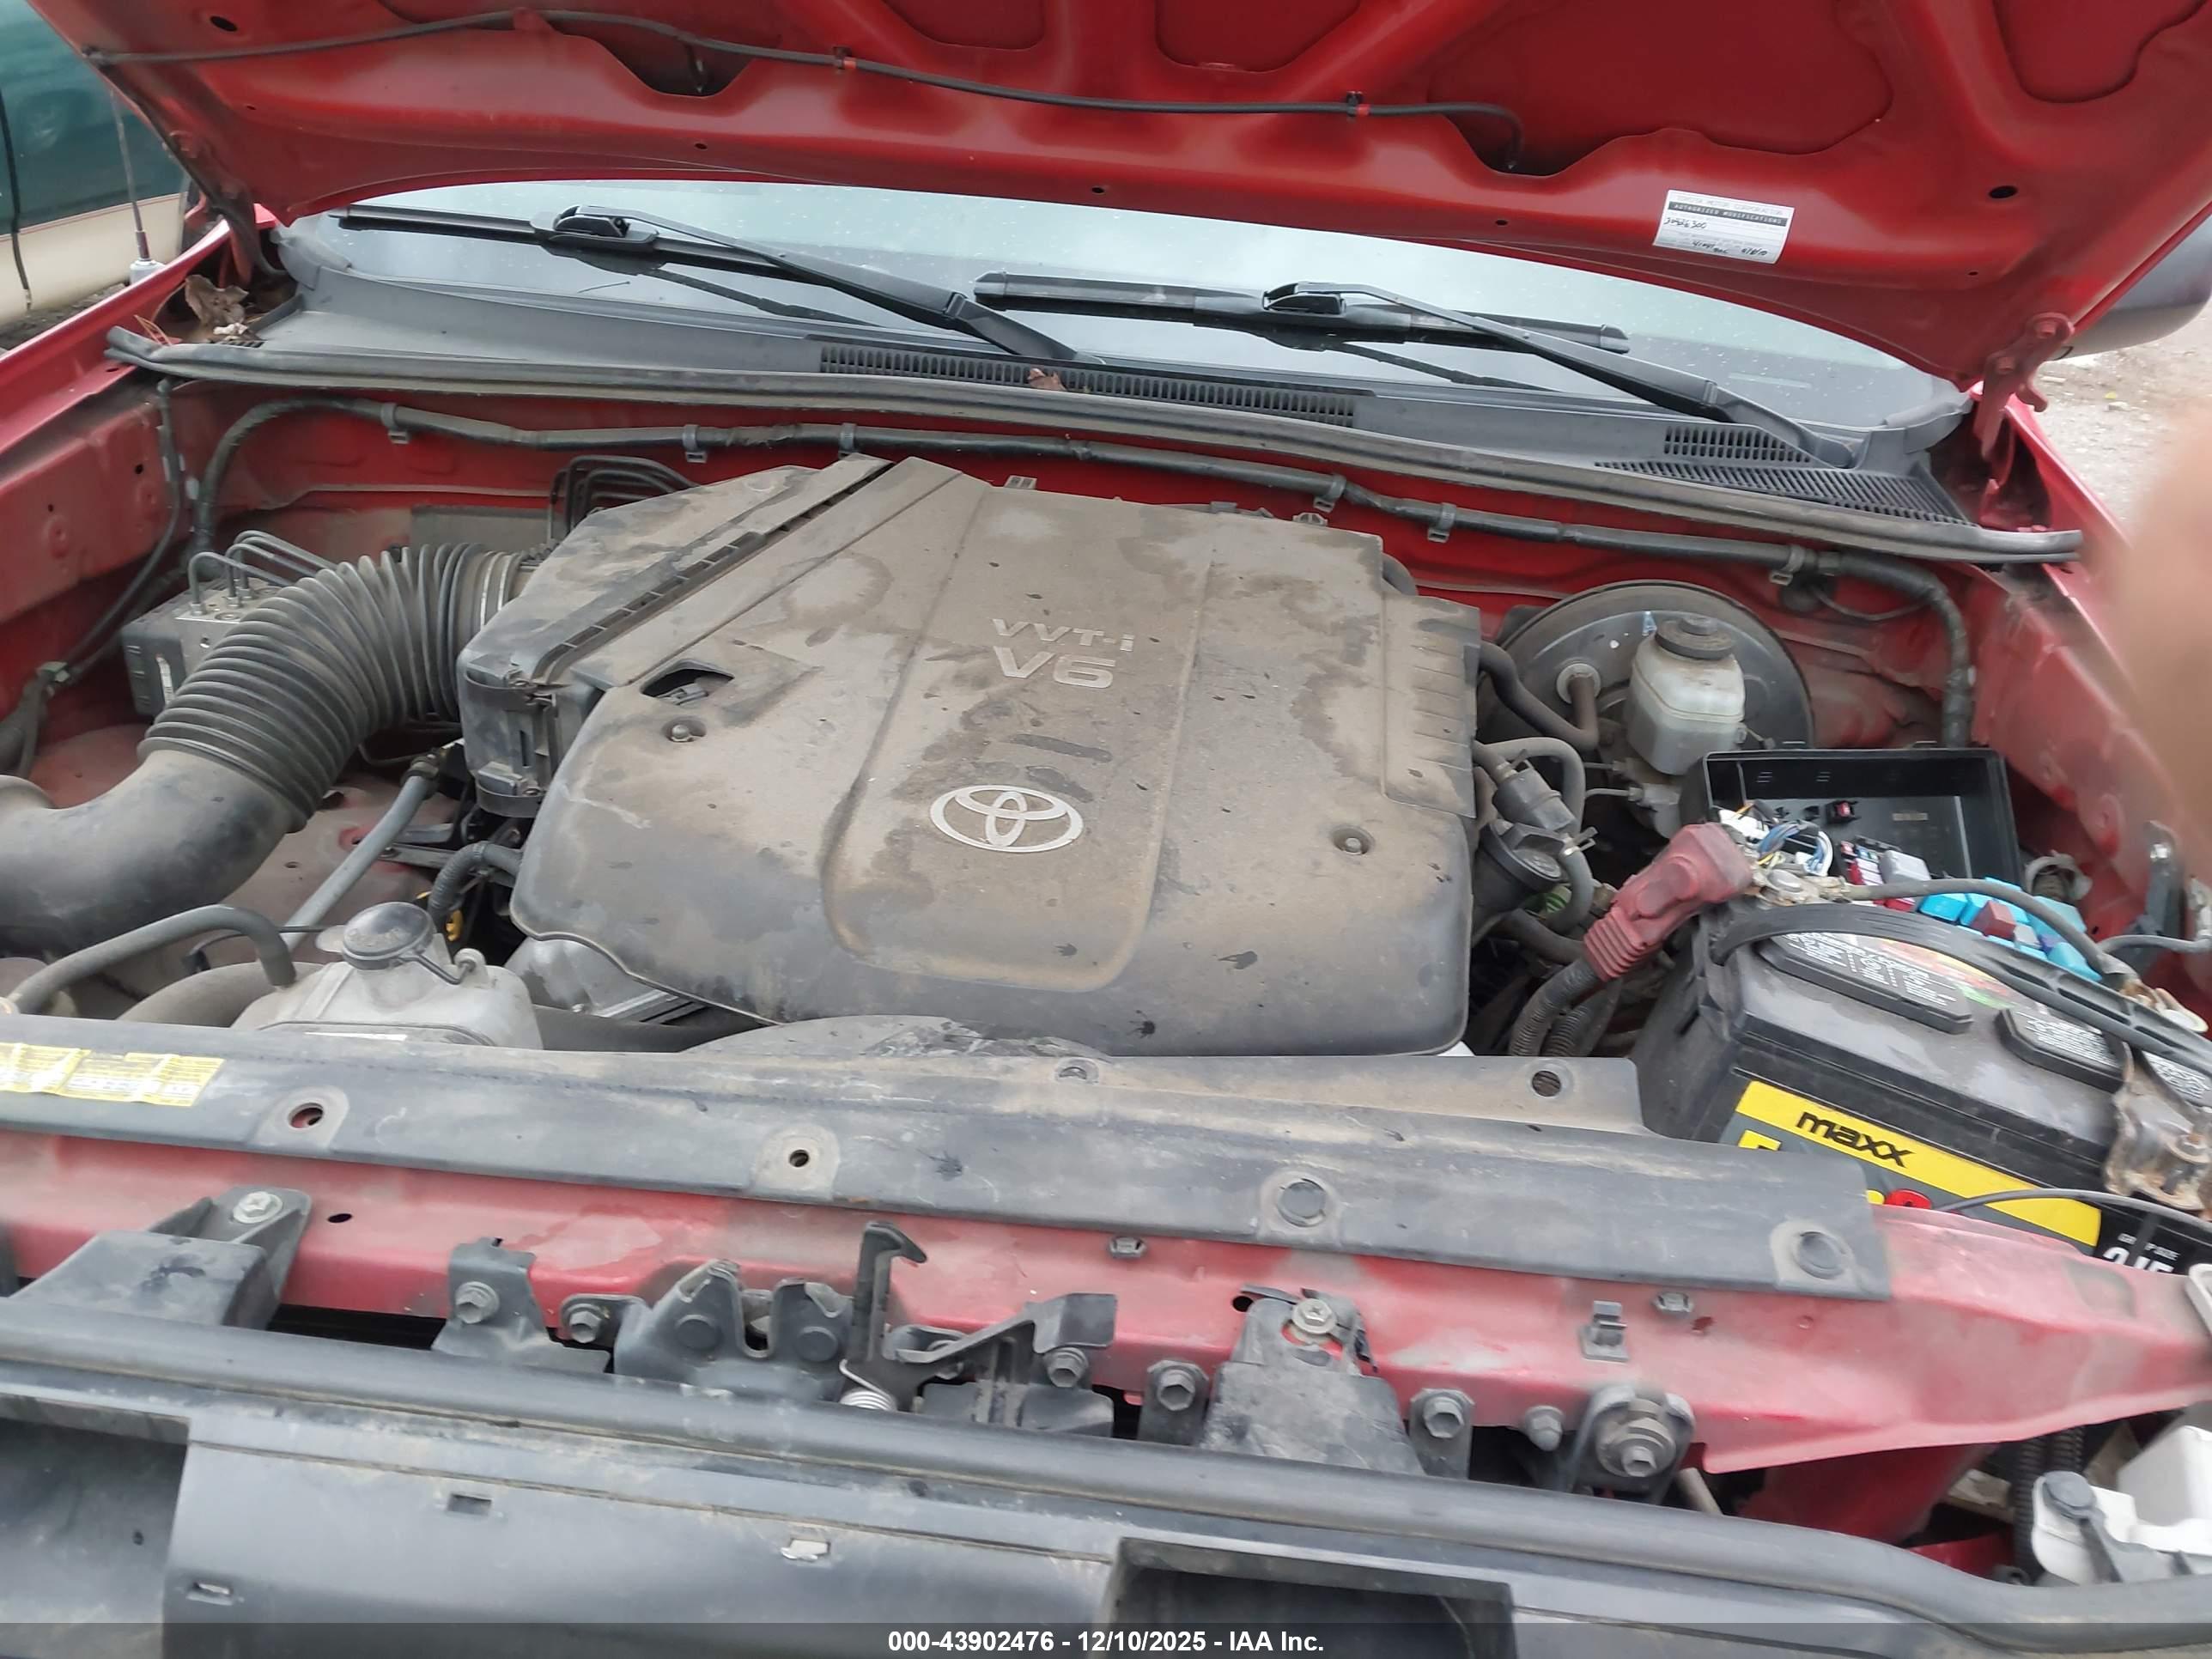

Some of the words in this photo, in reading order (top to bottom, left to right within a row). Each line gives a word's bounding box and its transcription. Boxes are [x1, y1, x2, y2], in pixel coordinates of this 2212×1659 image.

[1674, 203, 1720, 216] AUTHORIZED
[1723, 210, 1783, 224] MODIFICATIONS
[992, 618, 1135, 652] VVT-i
[993, 645, 1116, 690] V6
[1795, 1111, 1915, 1169] maxx
